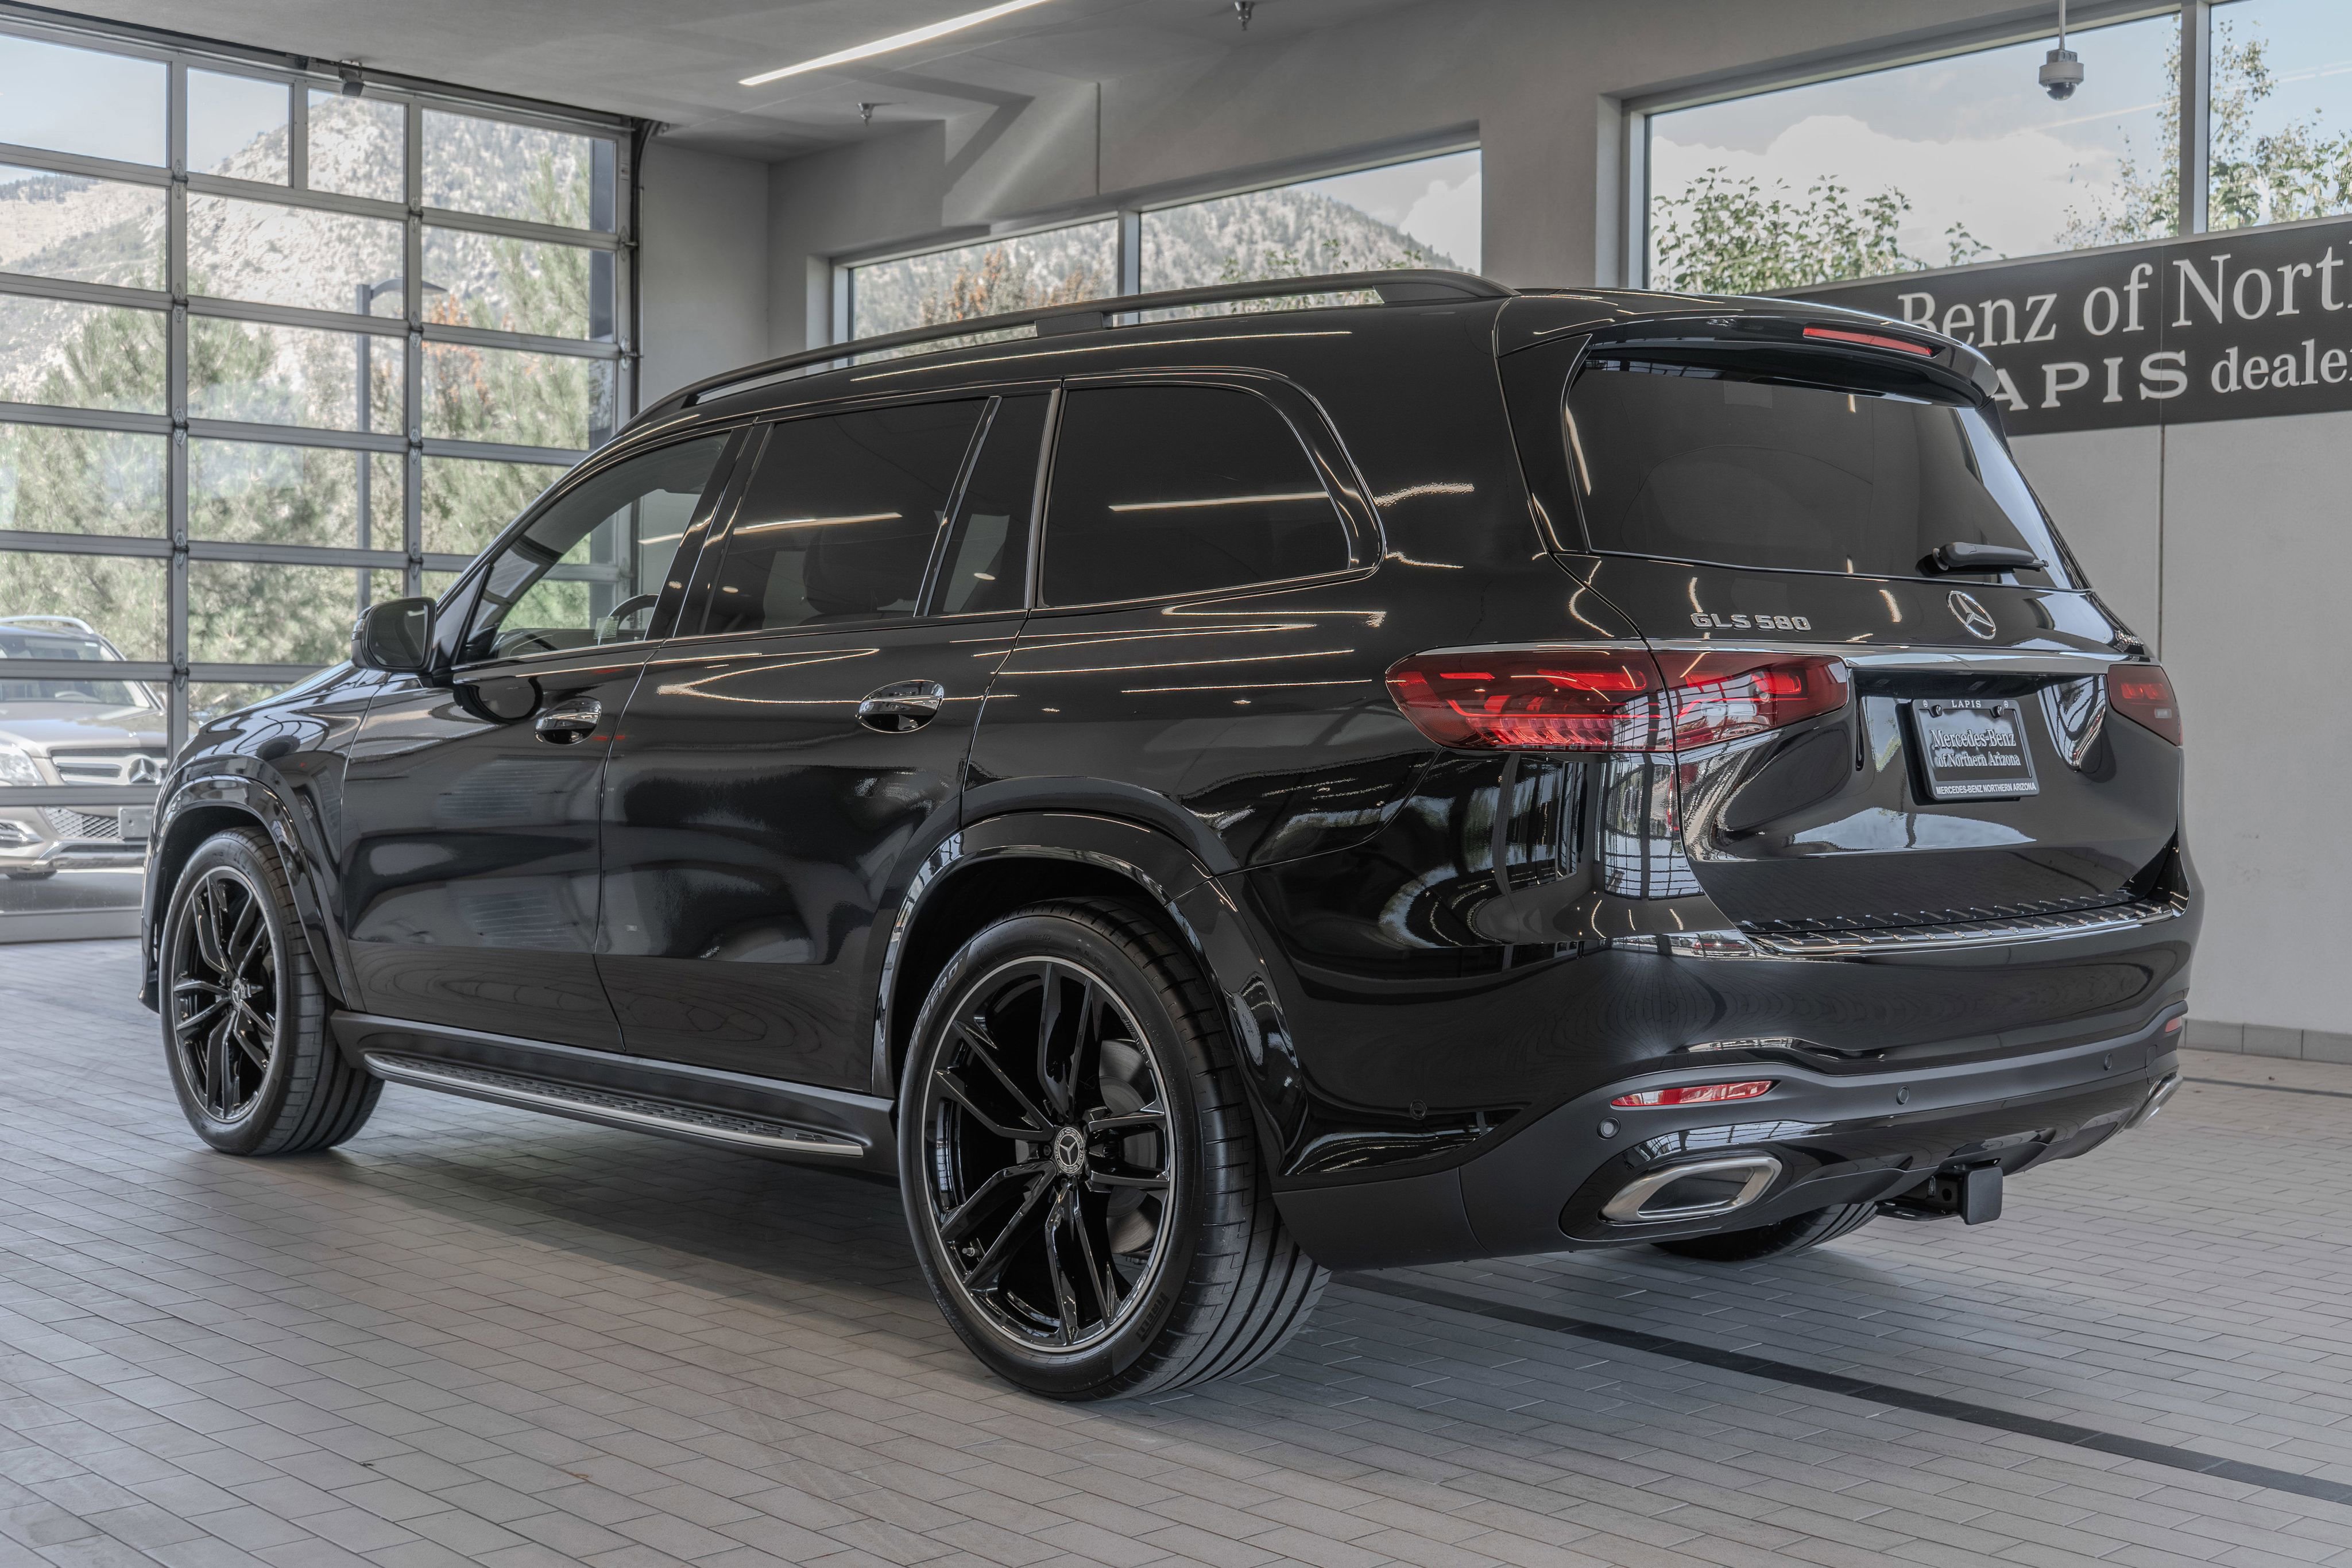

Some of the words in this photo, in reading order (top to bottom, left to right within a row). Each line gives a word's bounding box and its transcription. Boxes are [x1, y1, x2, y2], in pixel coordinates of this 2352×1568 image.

[1897, 292, 2057, 348] Benz
[2083, 262, 2153, 336] of
[2172, 240, 2352, 328] Nort
[2211, 338, 2352, 394] deale
[1690, 613, 1751, 630] GLS
[1754, 614, 1812, 632] 580
[1951, 700, 1982, 708] LAPIS
[1930, 729, 2017, 748] Mercedes-Benz
[1938, 753, 1948, 767] of
[1947, 753, 1989, 767] Northern
[1988, 751, 2021, 766] Arizona
[1936, 785, 1983, 795] MERCEDES-BENZ
[1983, 783, 2013, 793] NORTHERN
[2013, 781, 2037, 791] ARIZONA
[923, 961, 959, 1025] ZERO
